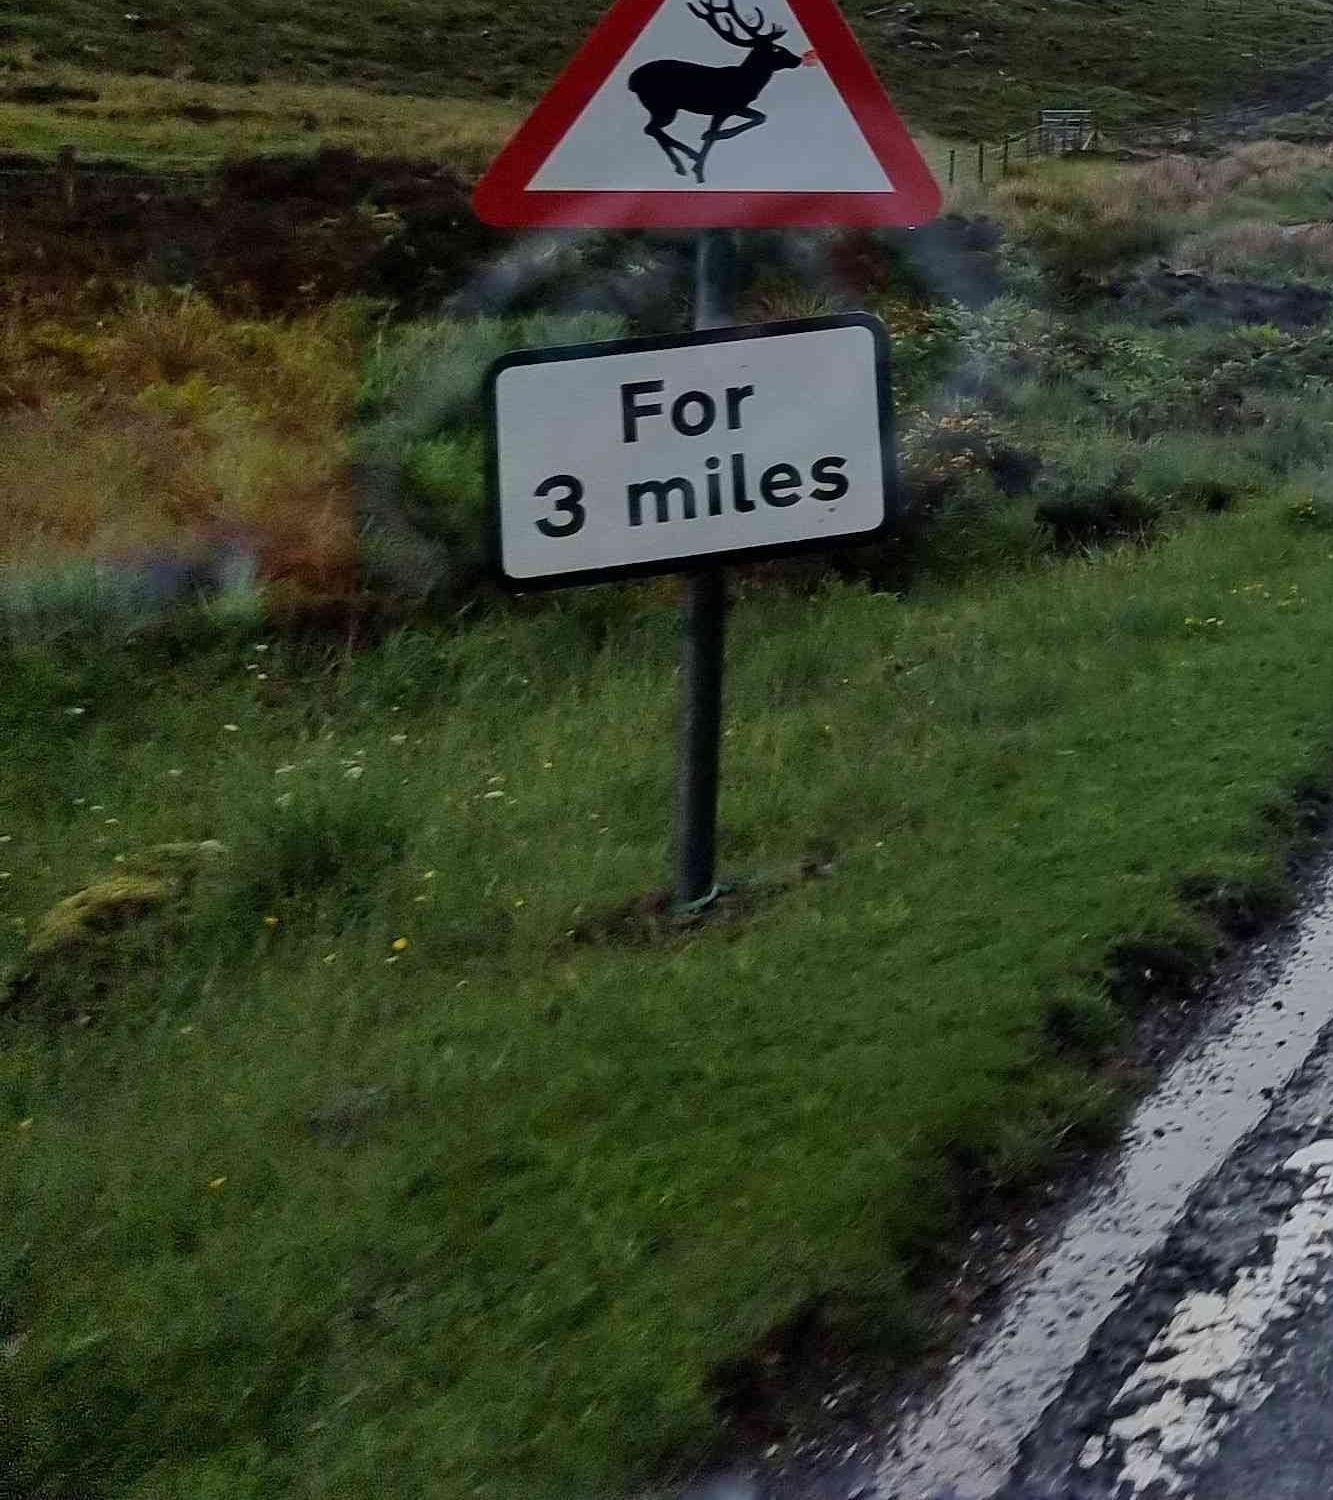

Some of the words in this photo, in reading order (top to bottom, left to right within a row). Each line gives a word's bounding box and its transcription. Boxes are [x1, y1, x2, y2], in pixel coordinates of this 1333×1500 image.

[620, 379, 754, 443] For
[533, 474, 586, 538] 3
[626, 453, 850, 527] miles
